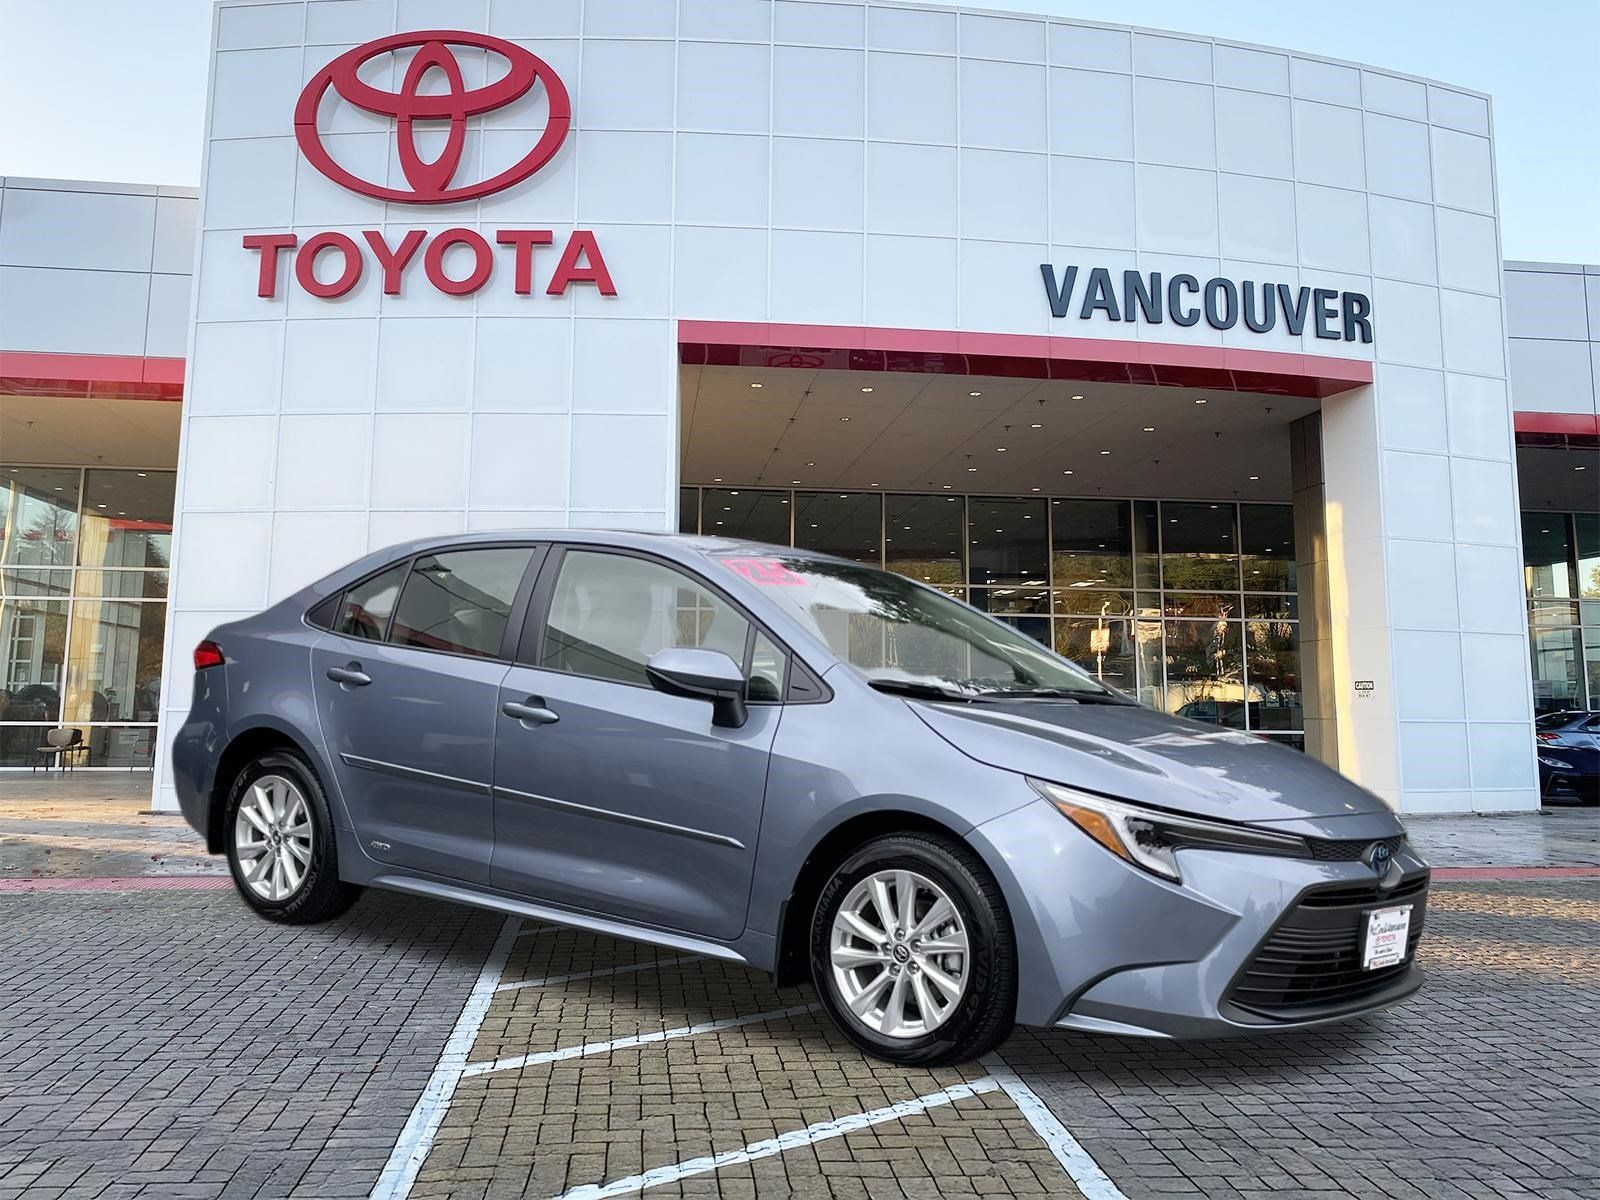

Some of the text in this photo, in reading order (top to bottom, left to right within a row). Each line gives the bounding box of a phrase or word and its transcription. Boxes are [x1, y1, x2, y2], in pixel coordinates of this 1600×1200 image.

[243, 228, 617, 299] TOYOTA
[1040, 263, 1373, 344] VANCOUVER
[285, 871, 320, 913] YOKOHAMA
